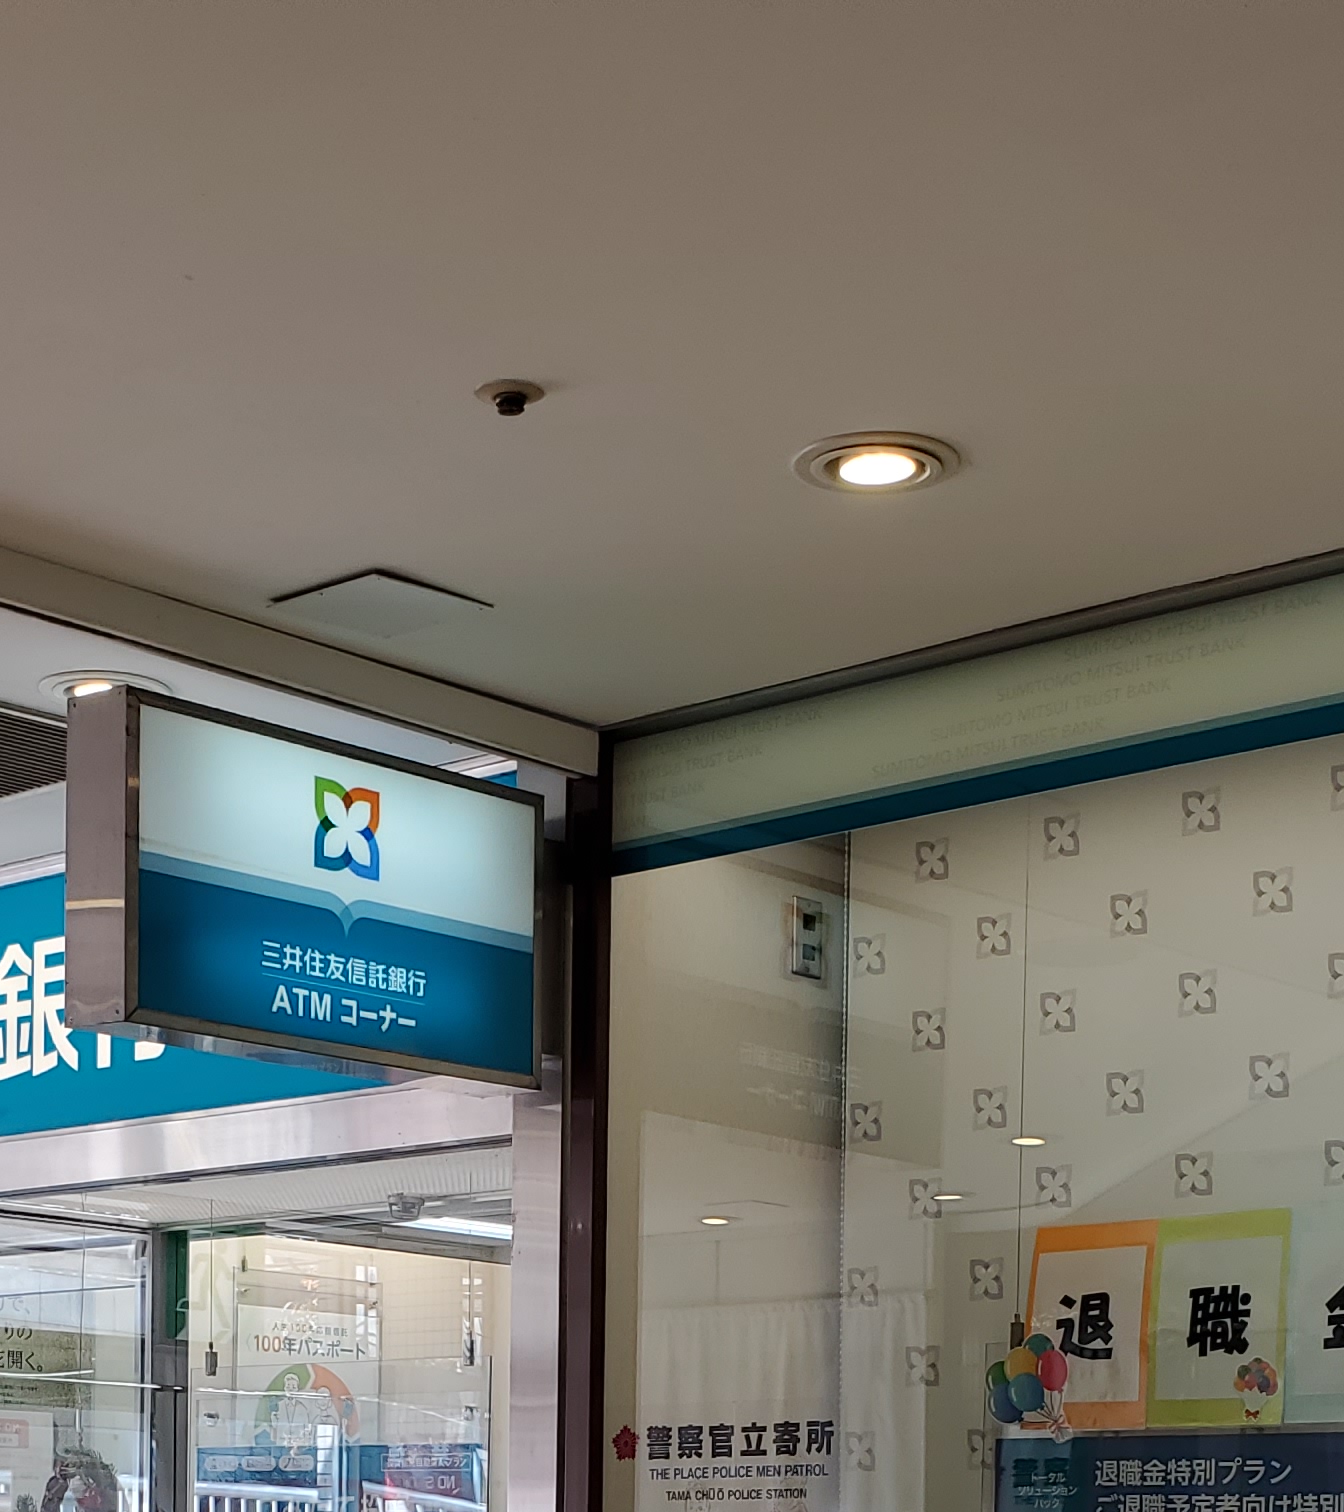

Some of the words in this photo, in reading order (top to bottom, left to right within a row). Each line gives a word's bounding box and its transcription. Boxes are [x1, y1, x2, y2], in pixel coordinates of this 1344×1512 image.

[261, 940, 427, 997] 三井住友信託銀行
[271, 984, 332, 1022] ATM
[340, 998, 416, 1033] コーナー
[646, 1420, 835, 1461] 警察官立寄所
[649, 1467, 671, 1480] THE
[674, 1466, 709, 1480] PLACE
[712, 1465, 754, 1479] POLICE
[756, 1464, 781, 1478] MEN
[784, 1463, 829, 1477] PATROL
[1095, 1457, 1293, 1488] 退職金特別プラン
[666, 1490, 692, 1501] TAMA
[727, 1489, 762, 1500] POLICE
[765, 1488, 808, 1500] STATION
